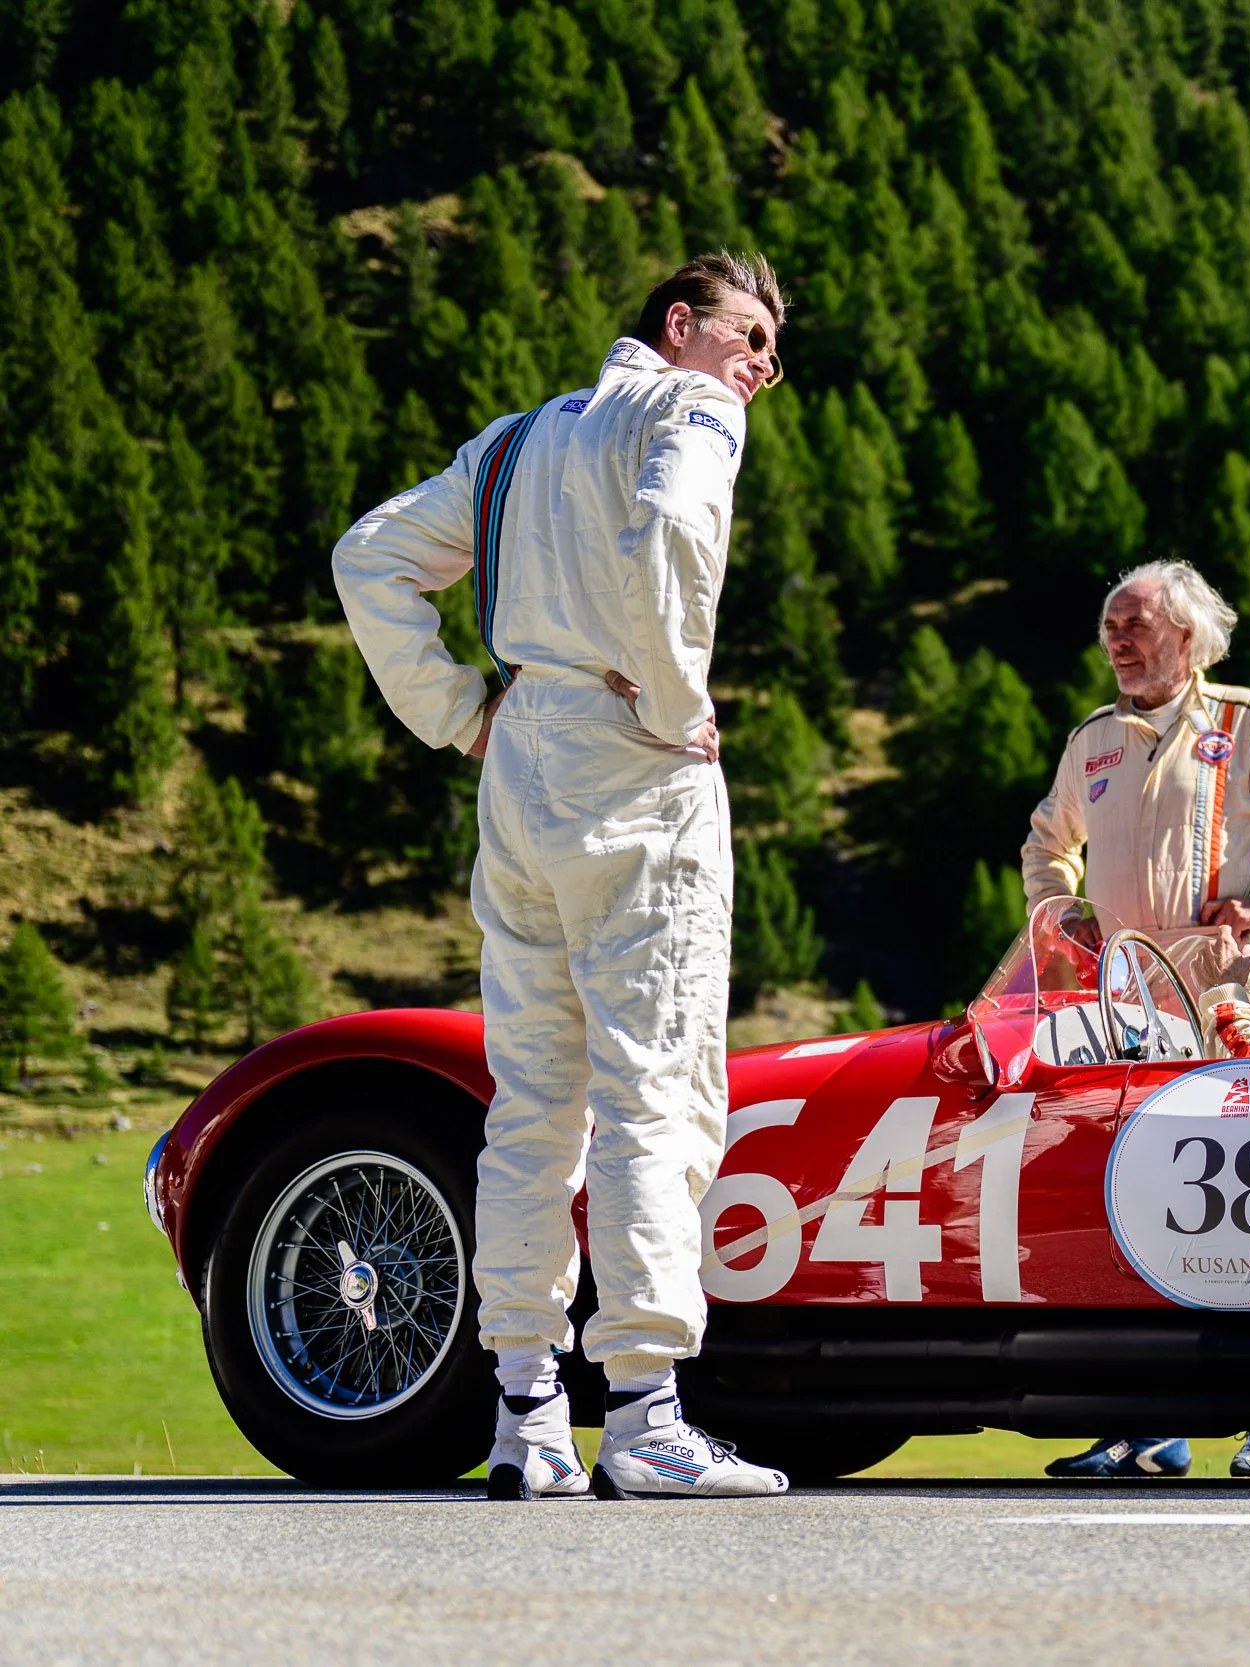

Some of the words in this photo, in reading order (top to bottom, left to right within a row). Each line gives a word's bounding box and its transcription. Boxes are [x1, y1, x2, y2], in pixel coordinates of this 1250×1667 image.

[1221, 1105, 1250, 1113] BERNINA
[698, 1092, 1037, 1302] 641
[648, 1440, 695, 1458] sparco
